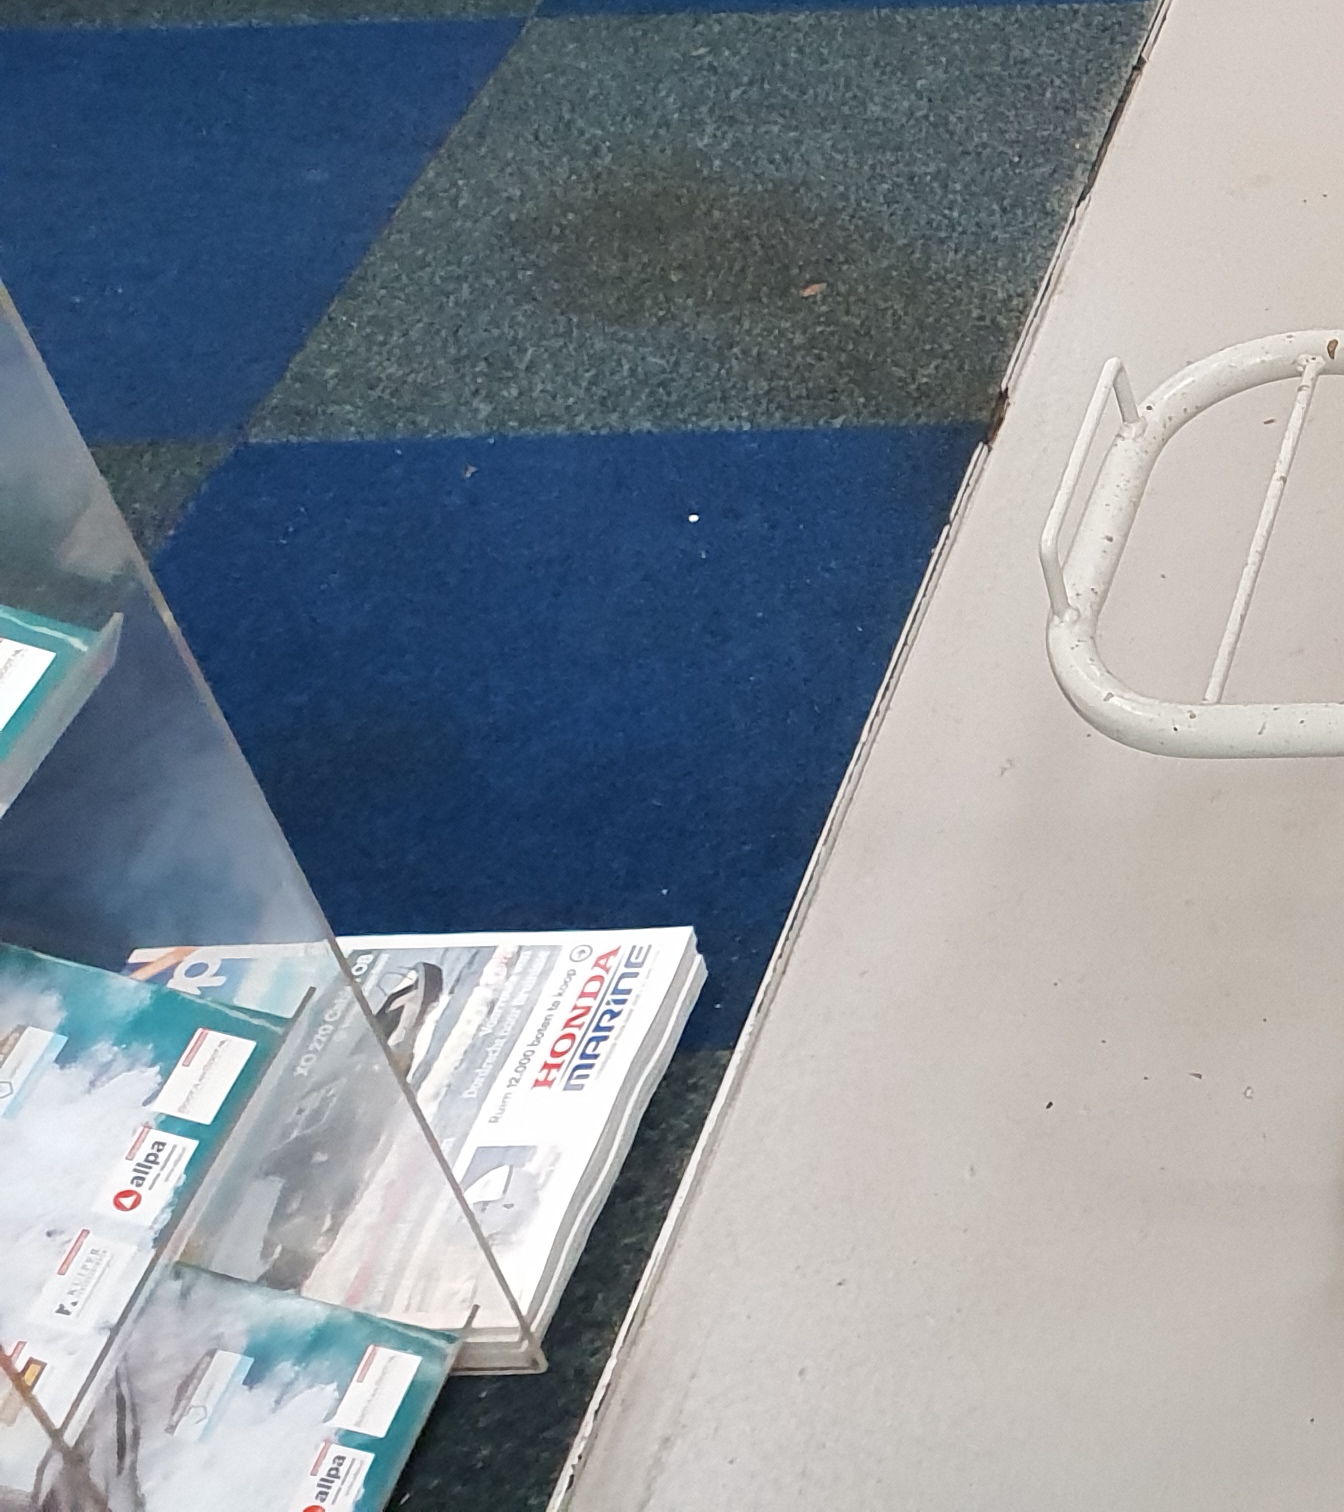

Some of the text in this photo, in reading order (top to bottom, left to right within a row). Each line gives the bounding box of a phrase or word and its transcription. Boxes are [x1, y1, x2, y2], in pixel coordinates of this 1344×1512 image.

[488, 1092, 512, 1124] Ruim
[507, 1049, 535, 1089] 12.000
[526, 1013, 554, 1047] boten
[552, 968, 577, 998] koop
[530, 945, 621, 1091] HONDA
[562, 944, 652, 1092] MARINE
[130, 1140, 167, 1188] allpa
[315, 1454, 347, 1503] allpa
